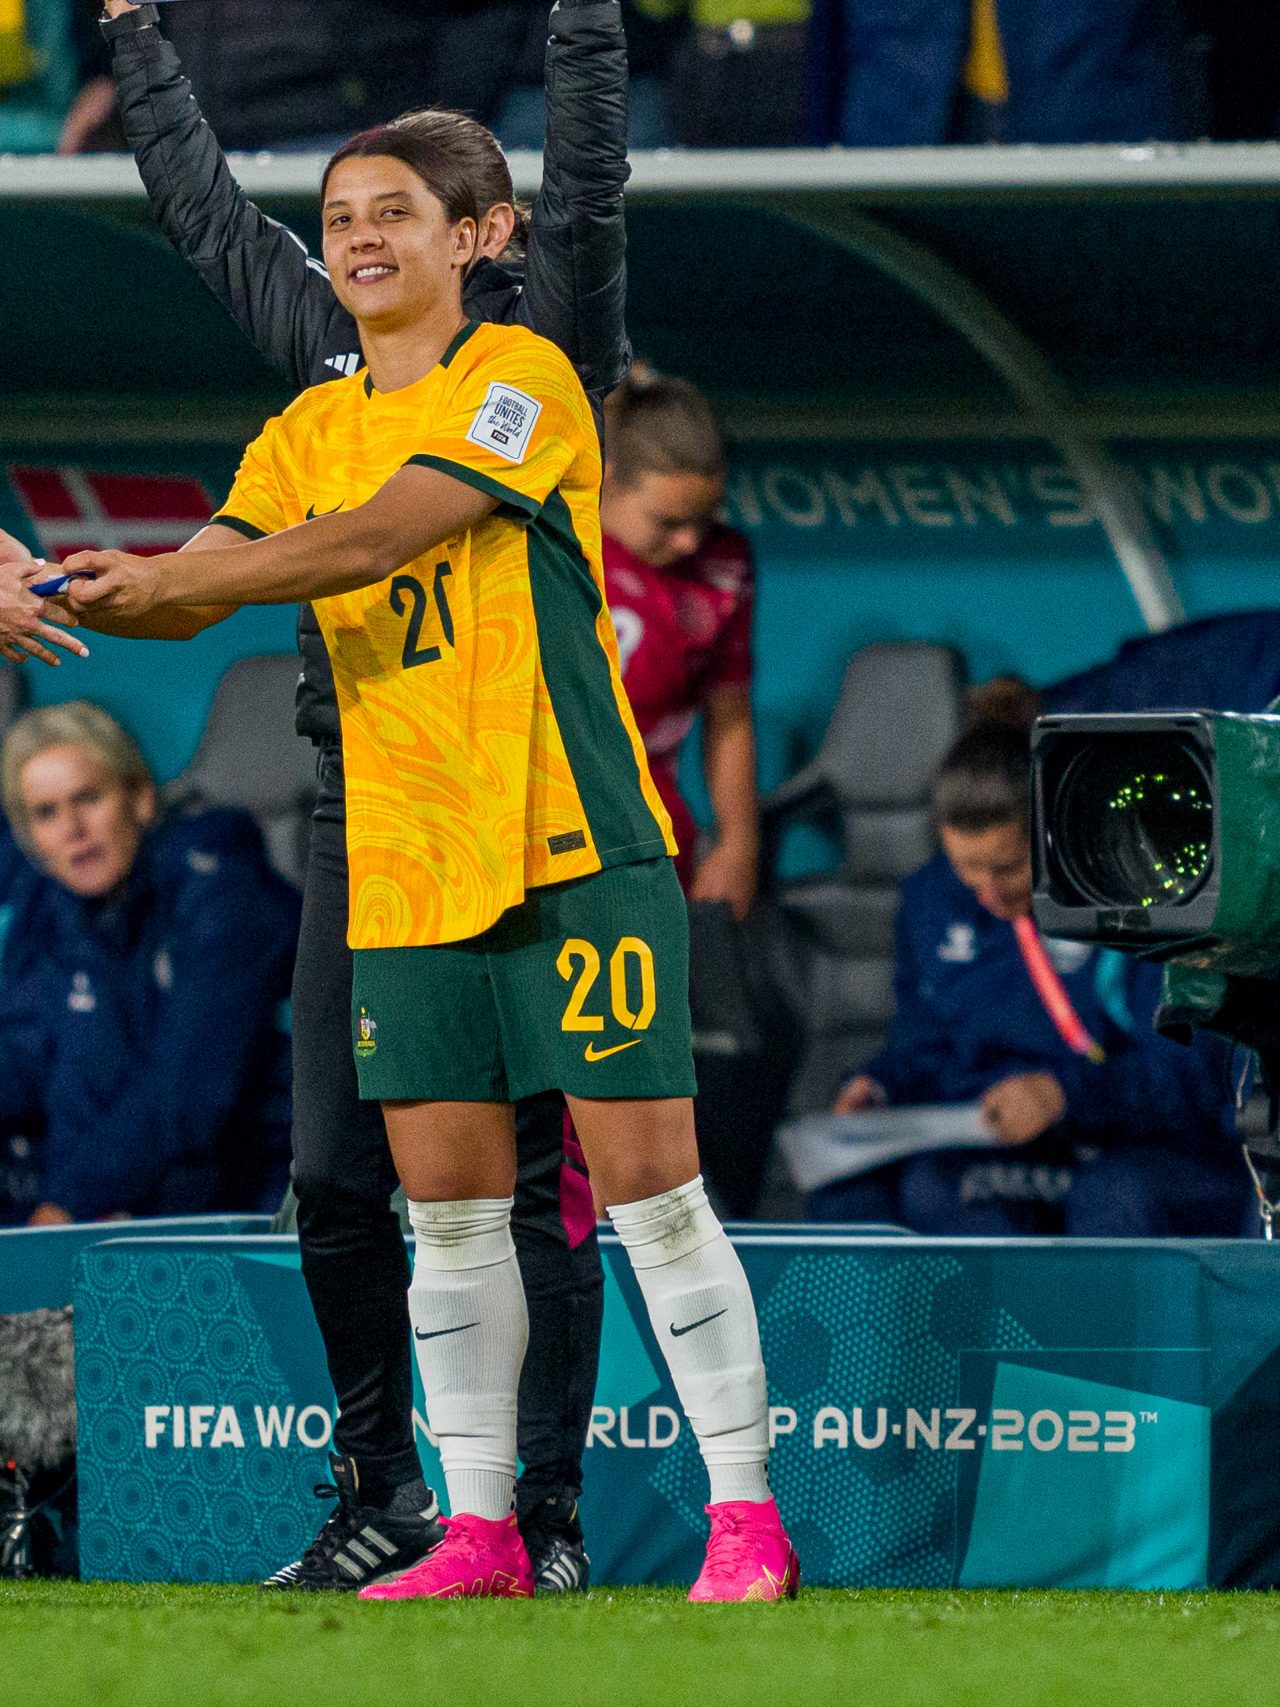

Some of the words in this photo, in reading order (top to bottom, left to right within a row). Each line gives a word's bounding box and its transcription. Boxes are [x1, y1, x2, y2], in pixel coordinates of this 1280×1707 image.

[494, 403, 525, 428] UNITES
[498, 395, 528, 417] FOOTBALL
[487, 415, 500, 427] the
[500, 420, 522, 440] World
[556, 936, 657, 1032] 20
[144, 1405, 245, 1449] FIFA
